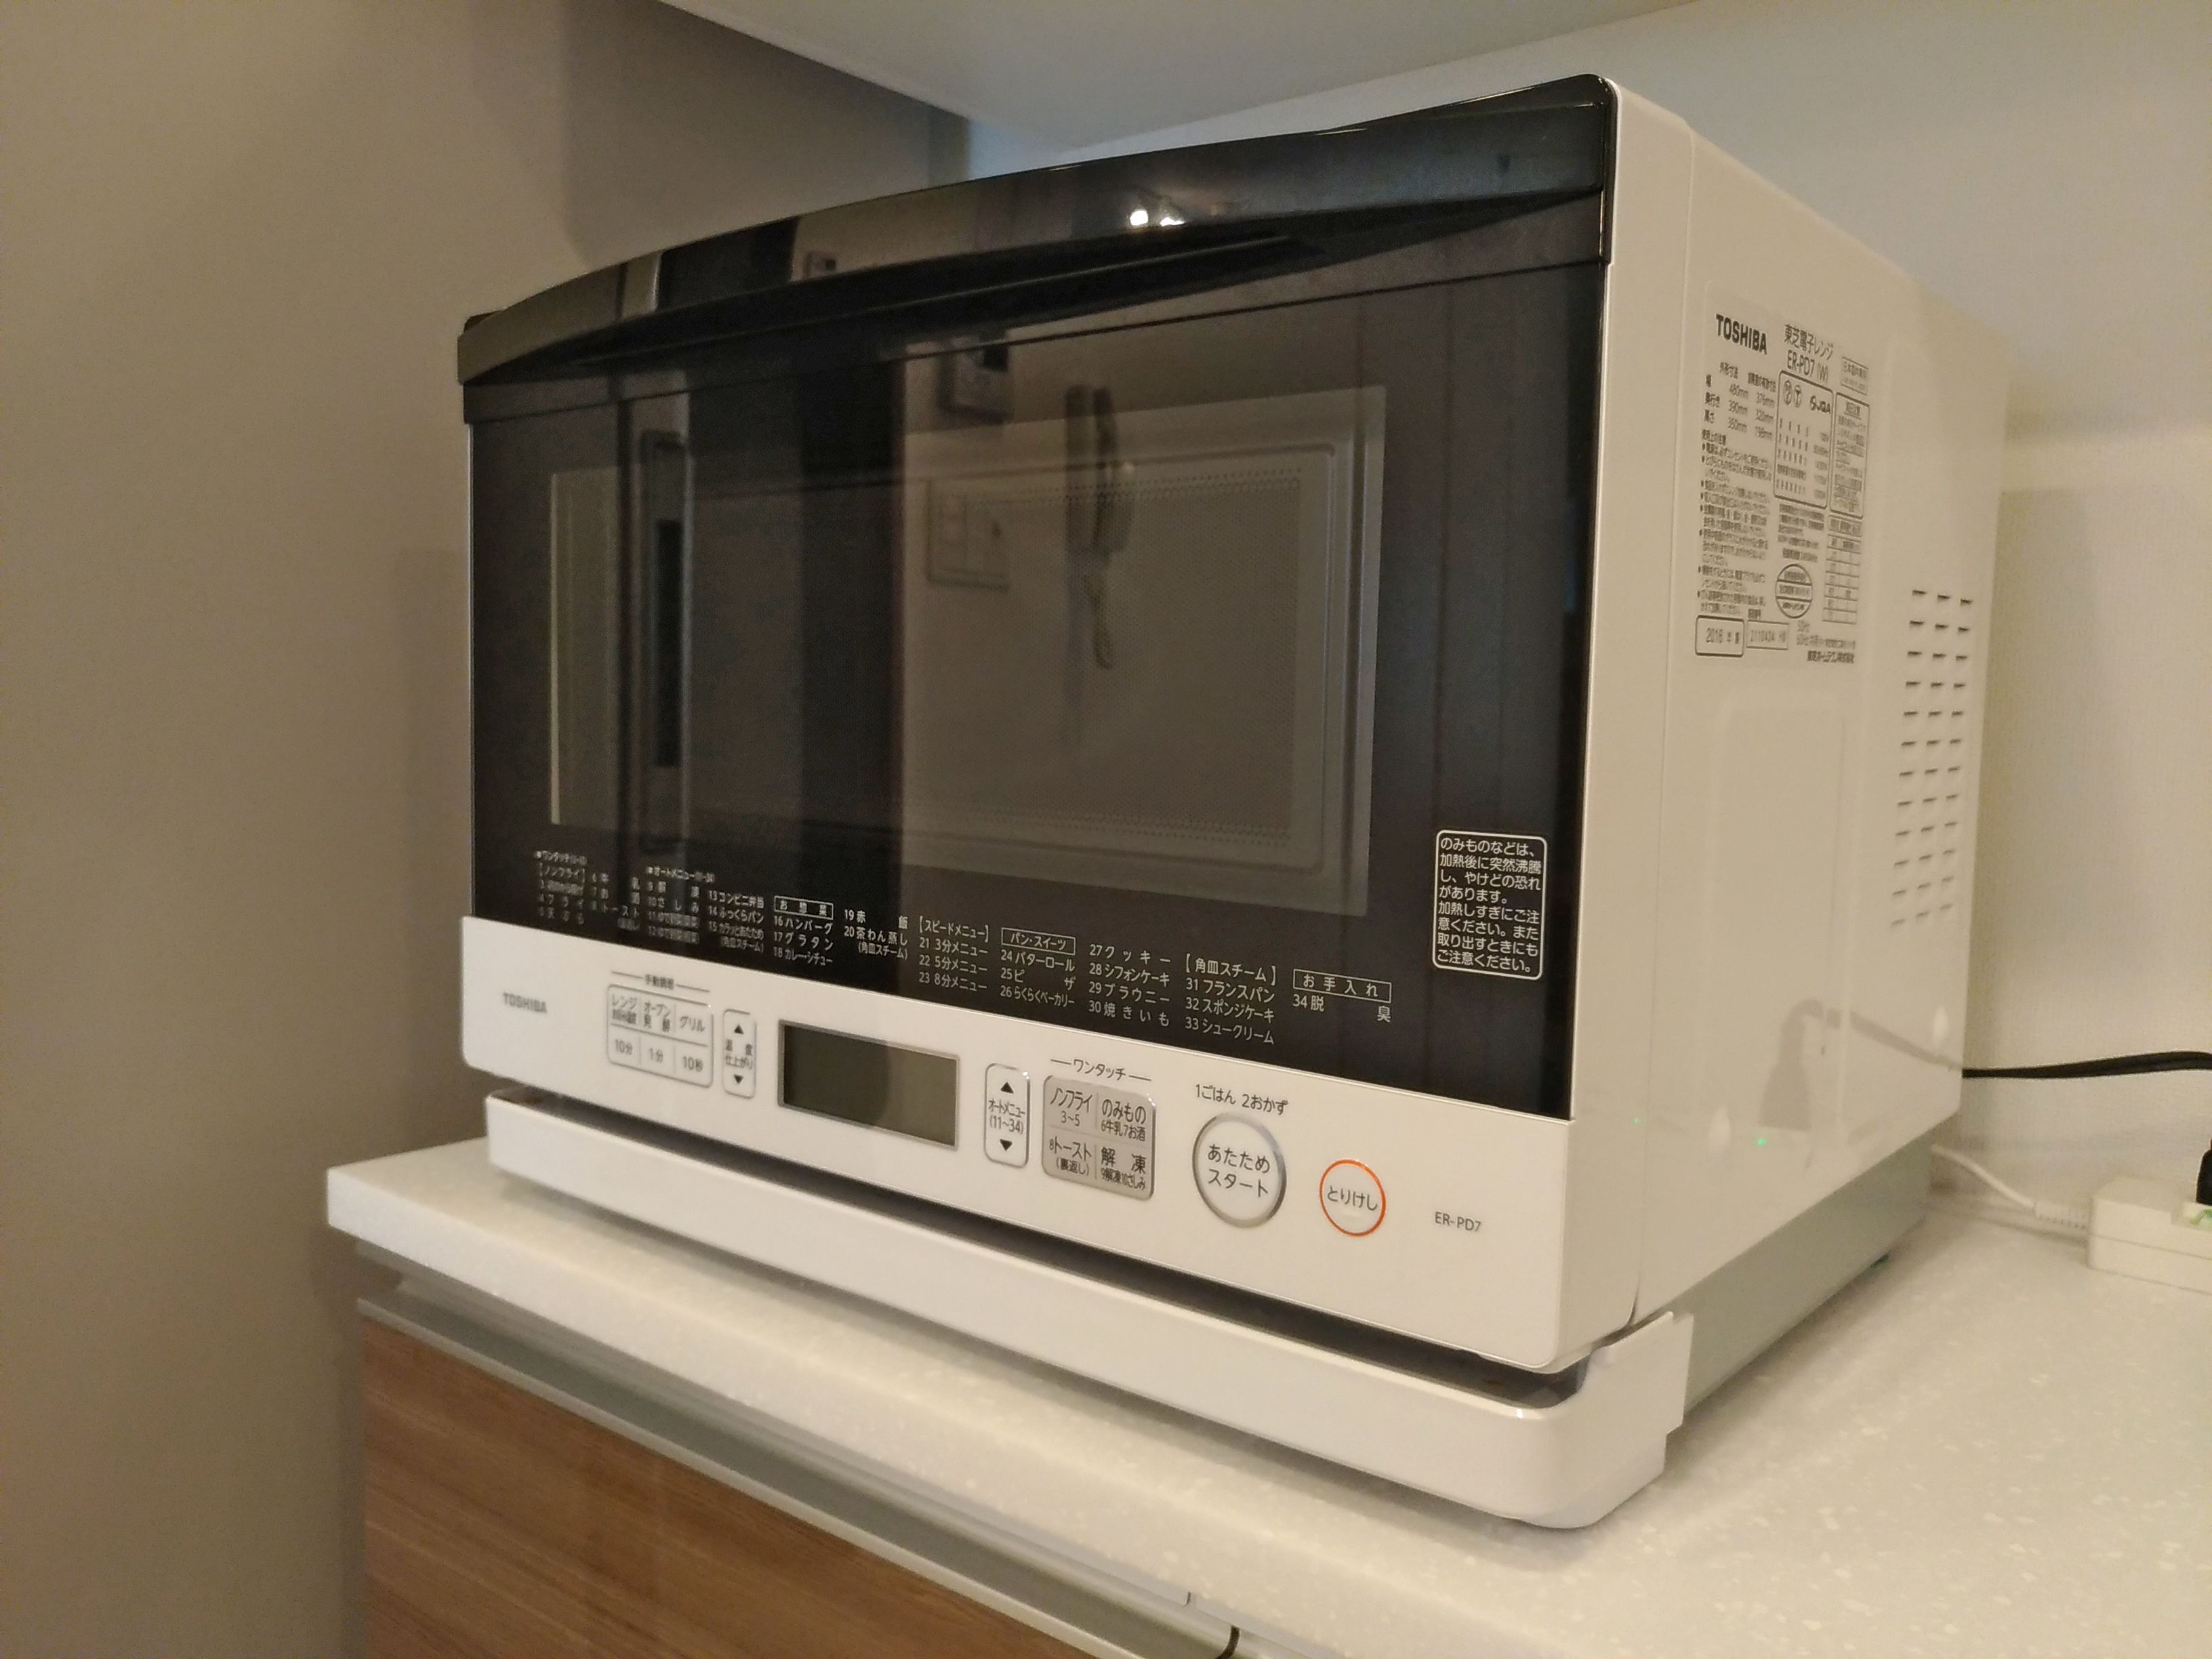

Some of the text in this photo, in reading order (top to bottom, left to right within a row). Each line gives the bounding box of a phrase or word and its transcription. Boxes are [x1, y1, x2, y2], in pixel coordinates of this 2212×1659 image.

[1715, 314, 1767, 354] TOSHIBA
[1784, 324, 1834, 360] 東芝電子レンジ
[1440, 838, 1535, 857] のみものなどは、
[1440, 854, 1542, 875] 加熱後に突然沸騰
[1440, 870, 1541, 890] し、やけどの恐れ
[719, 892, 764, 909] コンビニ弁当
[1439, 885, 1507, 904] があります。
[719, 907, 764, 924] ふっくらパン
[844, 909, 854, 920] 19
[1438, 901, 1540, 924] 加熱しすぎにご注
[844, 926, 908, 946] 20 茶わん蒸し
[1438, 918, 1538, 940] 意ください。また
[773, 946, 783, 958] 18
[919, 937, 988, 956] 21 3分メニュー
[1000, 949, 1012, 962] 24
[1437, 933, 1538, 957] 取り出すときにも
[919, 954, 988, 974] 22 5分メニュー
[1437, 949, 1531, 972] ご注意ください。
[919, 972, 987, 991] 23 8分メニュー
[1000, 968, 1012, 980] 25
[1000, 985, 1075, 1008] 26 らくらくベーカリー
[1186, 978, 1275, 1003] 31 フランスパン
[1302, 974, 1379, 998] お手入れ
[503, 992, 547, 1013] TOSHIBA
[1185, 998, 1275, 1023] 32 スポンジケーキ
[1292, 994, 1307, 1007] 34
[1088, 1000, 1170, 1027] 30 焼きいも
[679, 1016, 705, 1033] グリル
[1185, 1017, 1275, 1045] 33 シュークリーム
[615, 1039, 633, 1055] 10分
[649, 1047, 663, 1063] 1分
[682, 1055, 703, 1072] 10秒
[1073, 1059, 1126, 1081] ワンタッチ
[1050, 1088, 1093, 1113] ノンフライ
[1195, 1084, 1288, 1116] 1ごはん 2おかず
[1101, 1099, 1147, 1124] のみもの
[1049, 1136, 1092, 1160] 8トースト
[1057, 1157, 1089, 1176] (裏返し)
[1101, 1147, 1147, 1174] 解凍
[1207, 1144, 1271, 1174] あたため
[1208, 1169, 1269, 1197] スタート
[1327, 1185, 1378, 1212] とりけし
[1434, 1211, 1481, 1232] ER-PD7
